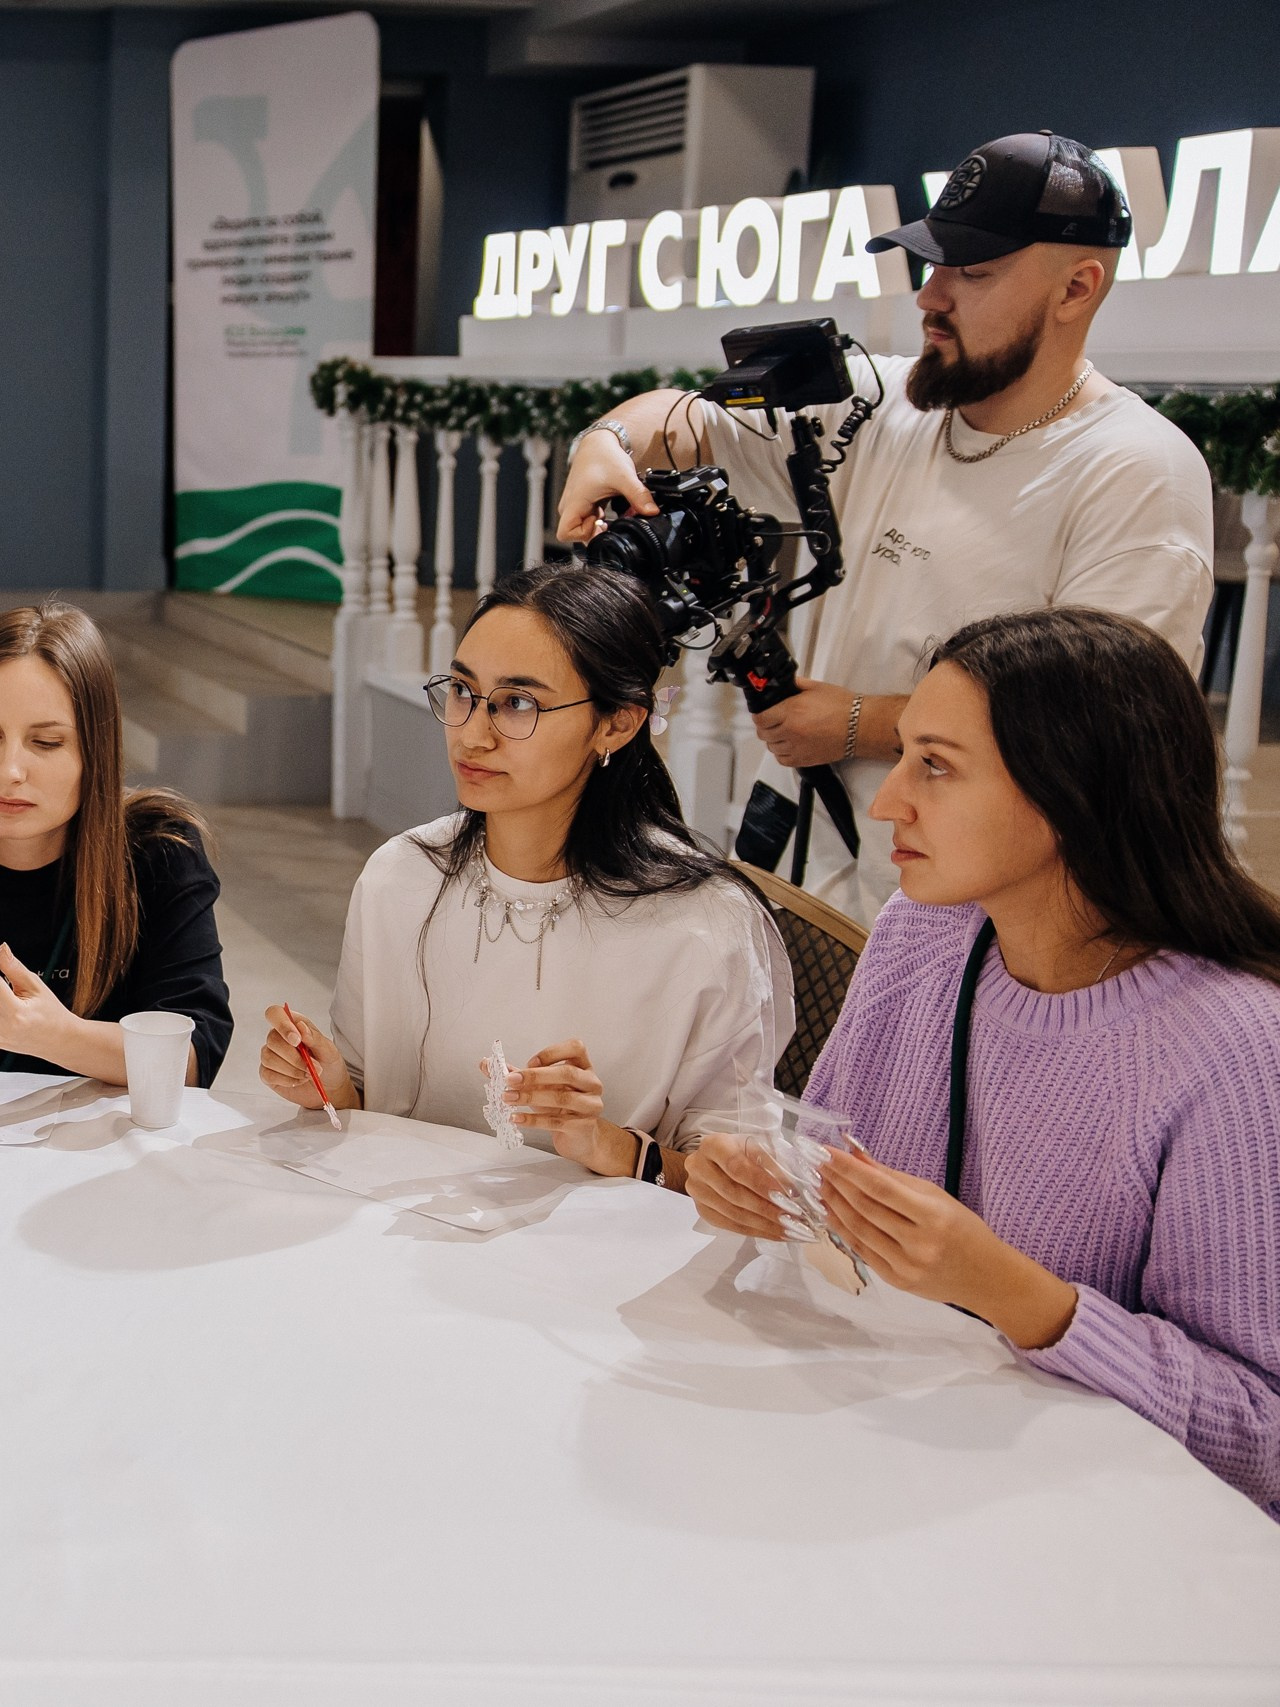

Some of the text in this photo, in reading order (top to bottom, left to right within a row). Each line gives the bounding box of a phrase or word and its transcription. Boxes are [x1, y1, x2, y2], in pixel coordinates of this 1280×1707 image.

[474, 218, 627, 320] ДРУГ
[639, 210, 683, 311] С
[697, 185, 882, 309] ЮГА
